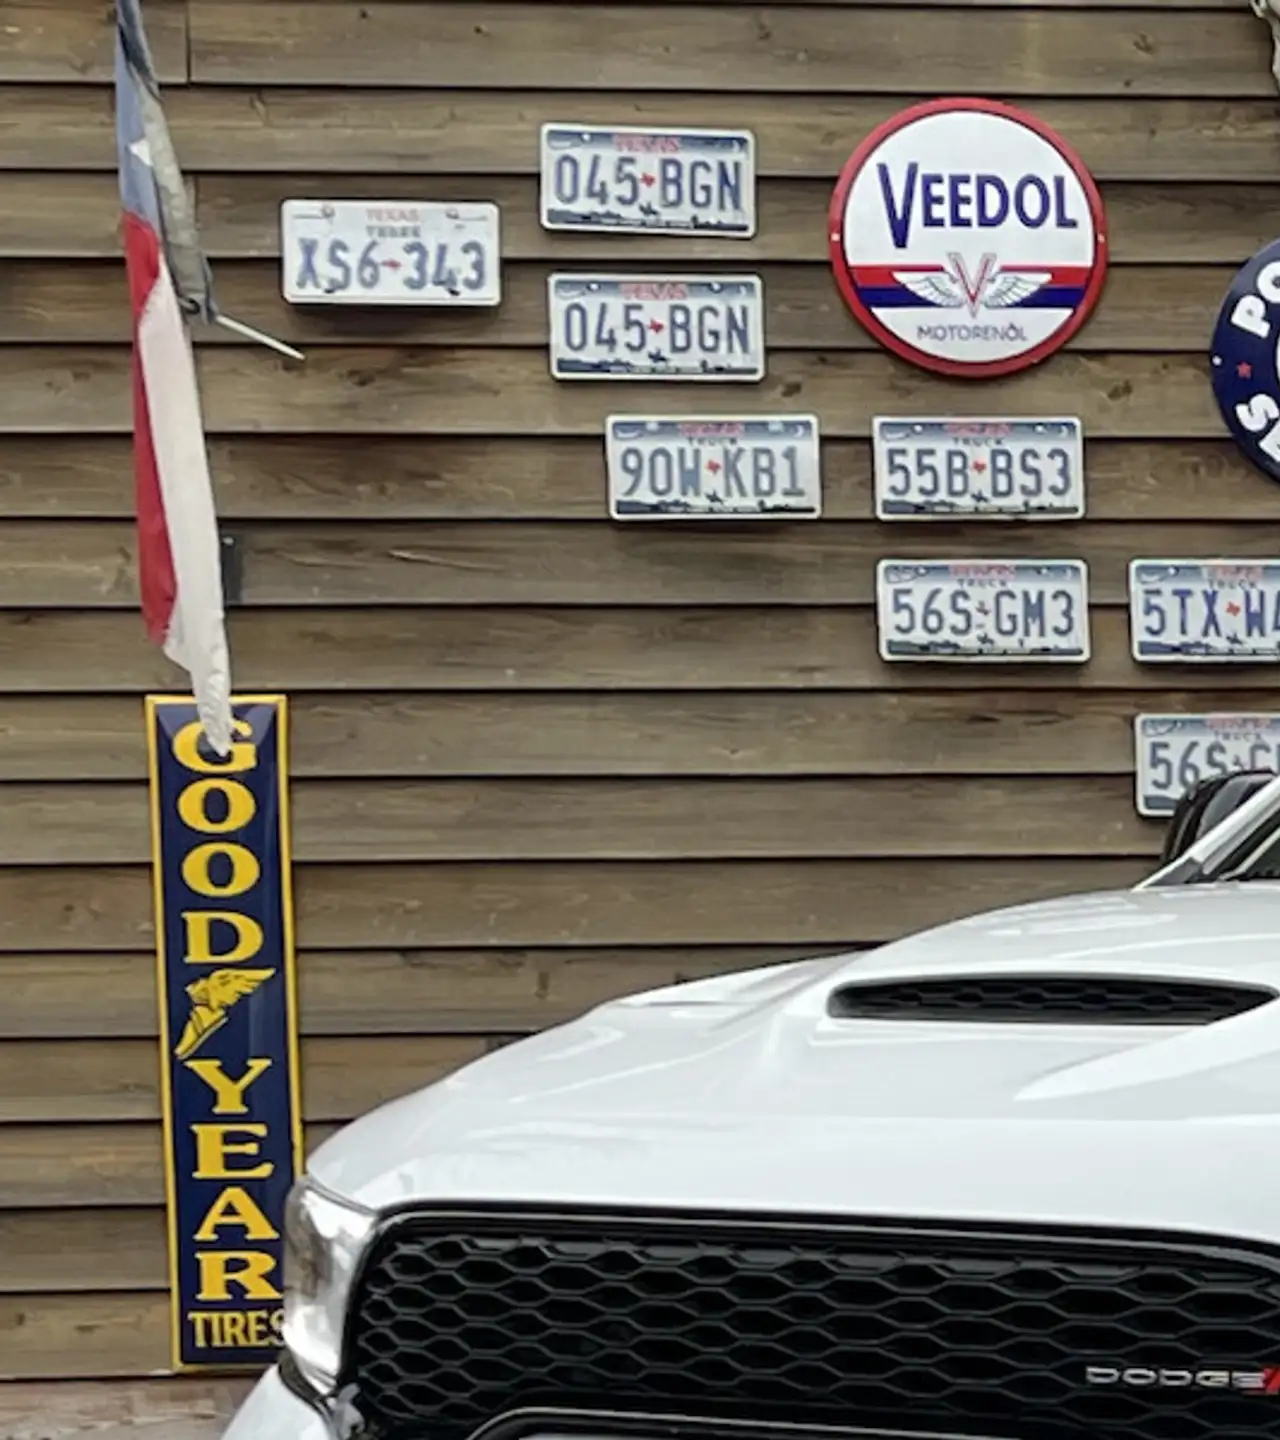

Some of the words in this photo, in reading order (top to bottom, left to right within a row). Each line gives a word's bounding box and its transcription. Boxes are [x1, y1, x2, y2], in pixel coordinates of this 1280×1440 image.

[555, 154, 640, 206] 045
[660, 158, 741, 211] BGN
[877, 162, 1079, 249] VEEDOL
[296, 237, 380, 290] XS6
[403, 240, 486, 291] 343
[564, 302, 647, 353] 045
[669, 304, 749, 354] BGN
[723, 445, 806, 498] KB1
[887, 448, 969, 497] 55B
[991, 448, 1071, 498] BS3
[892, 588, 972, 636] 56S
[995, 589, 1074, 638] GM3
[1142, 588, 1222, 637] 5TX
[187, 1308, 286, 1348] TIRES
[1085, 1366, 1268, 1389] DODGE
